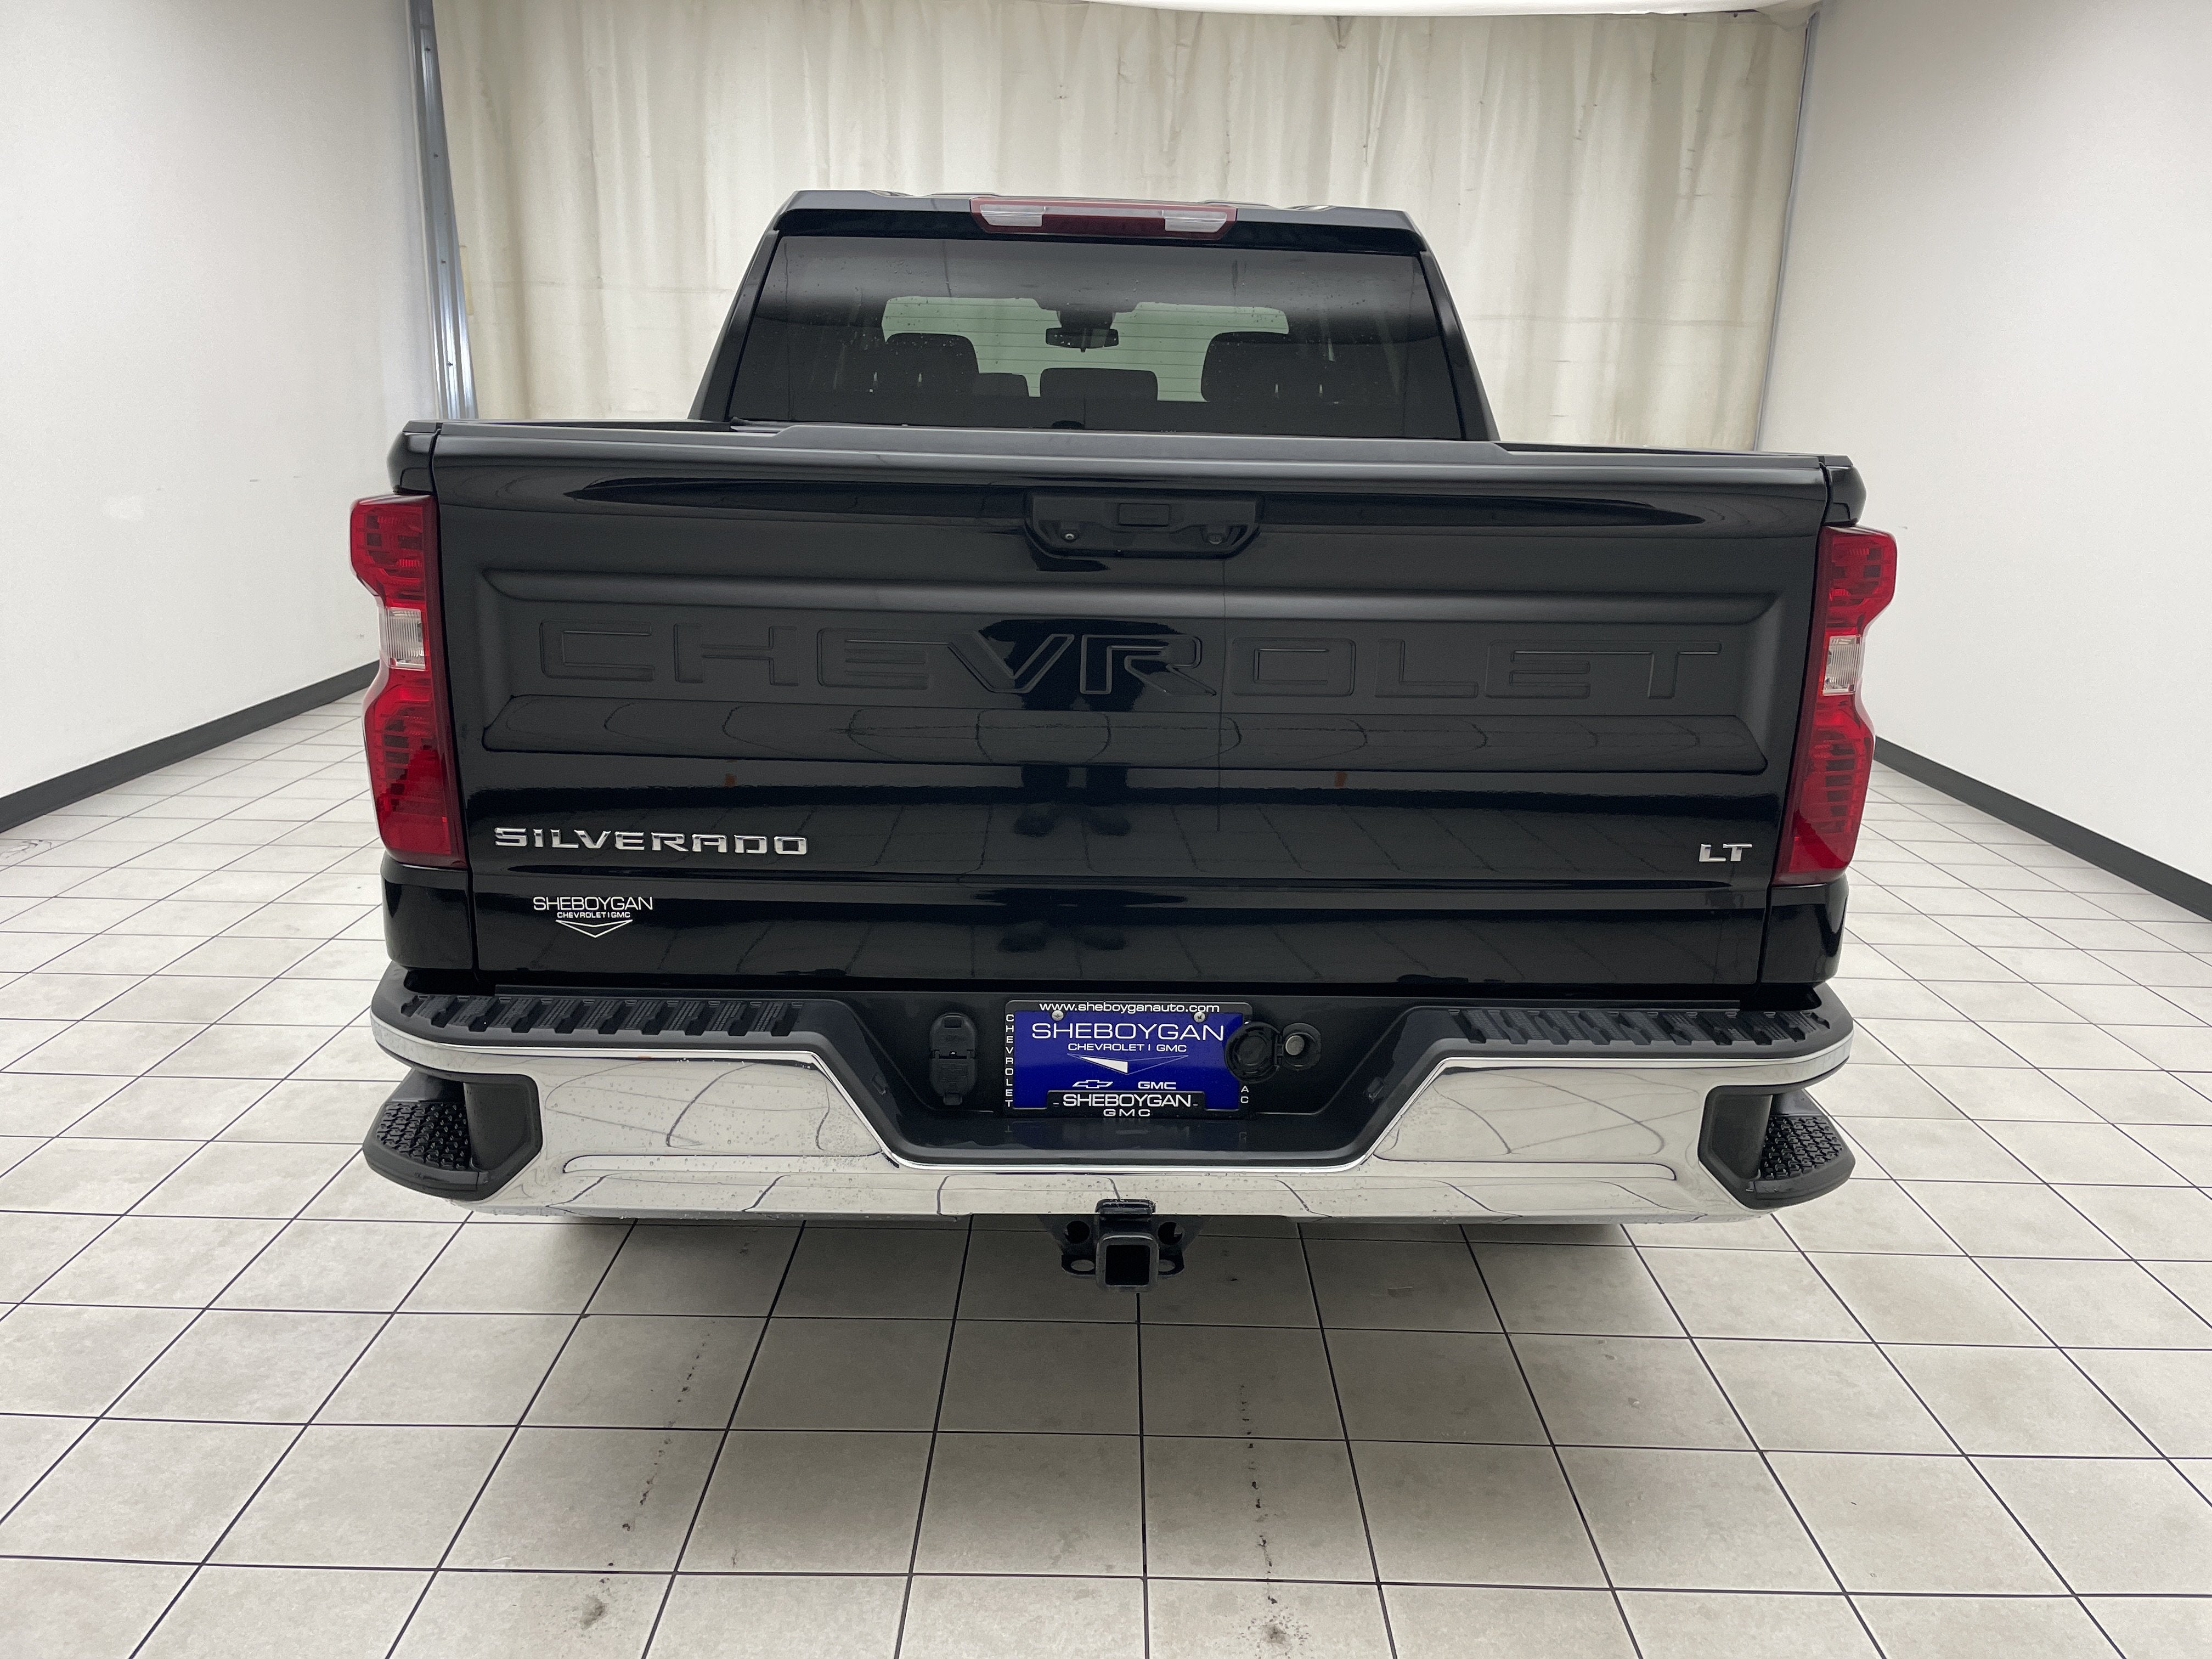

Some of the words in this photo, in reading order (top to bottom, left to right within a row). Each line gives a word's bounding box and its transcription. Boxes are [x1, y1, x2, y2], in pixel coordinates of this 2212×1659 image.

[539, 619, 1722, 699] CHEVROLET
[494, 827, 808, 855] SILVERADO
[1698, 843, 1753, 864] LT
[533, 896, 653, 911] SHEBOYGAN
[1039, 1002, 1220, 1015] www.sheboyganauto.com
[1031, 1022, 1224, 1041] SHEBOYGAN
[1068, 1043, 1145, 1051] CHEVROLET
[1156, 1044, 1187, 1052] GMC
[1137, 1081, 1177, 1090] GMC
[1062, 1093, 1192, 1108] SHEBOYGAN
[1103, 1109, 1151, 1117] GMC
